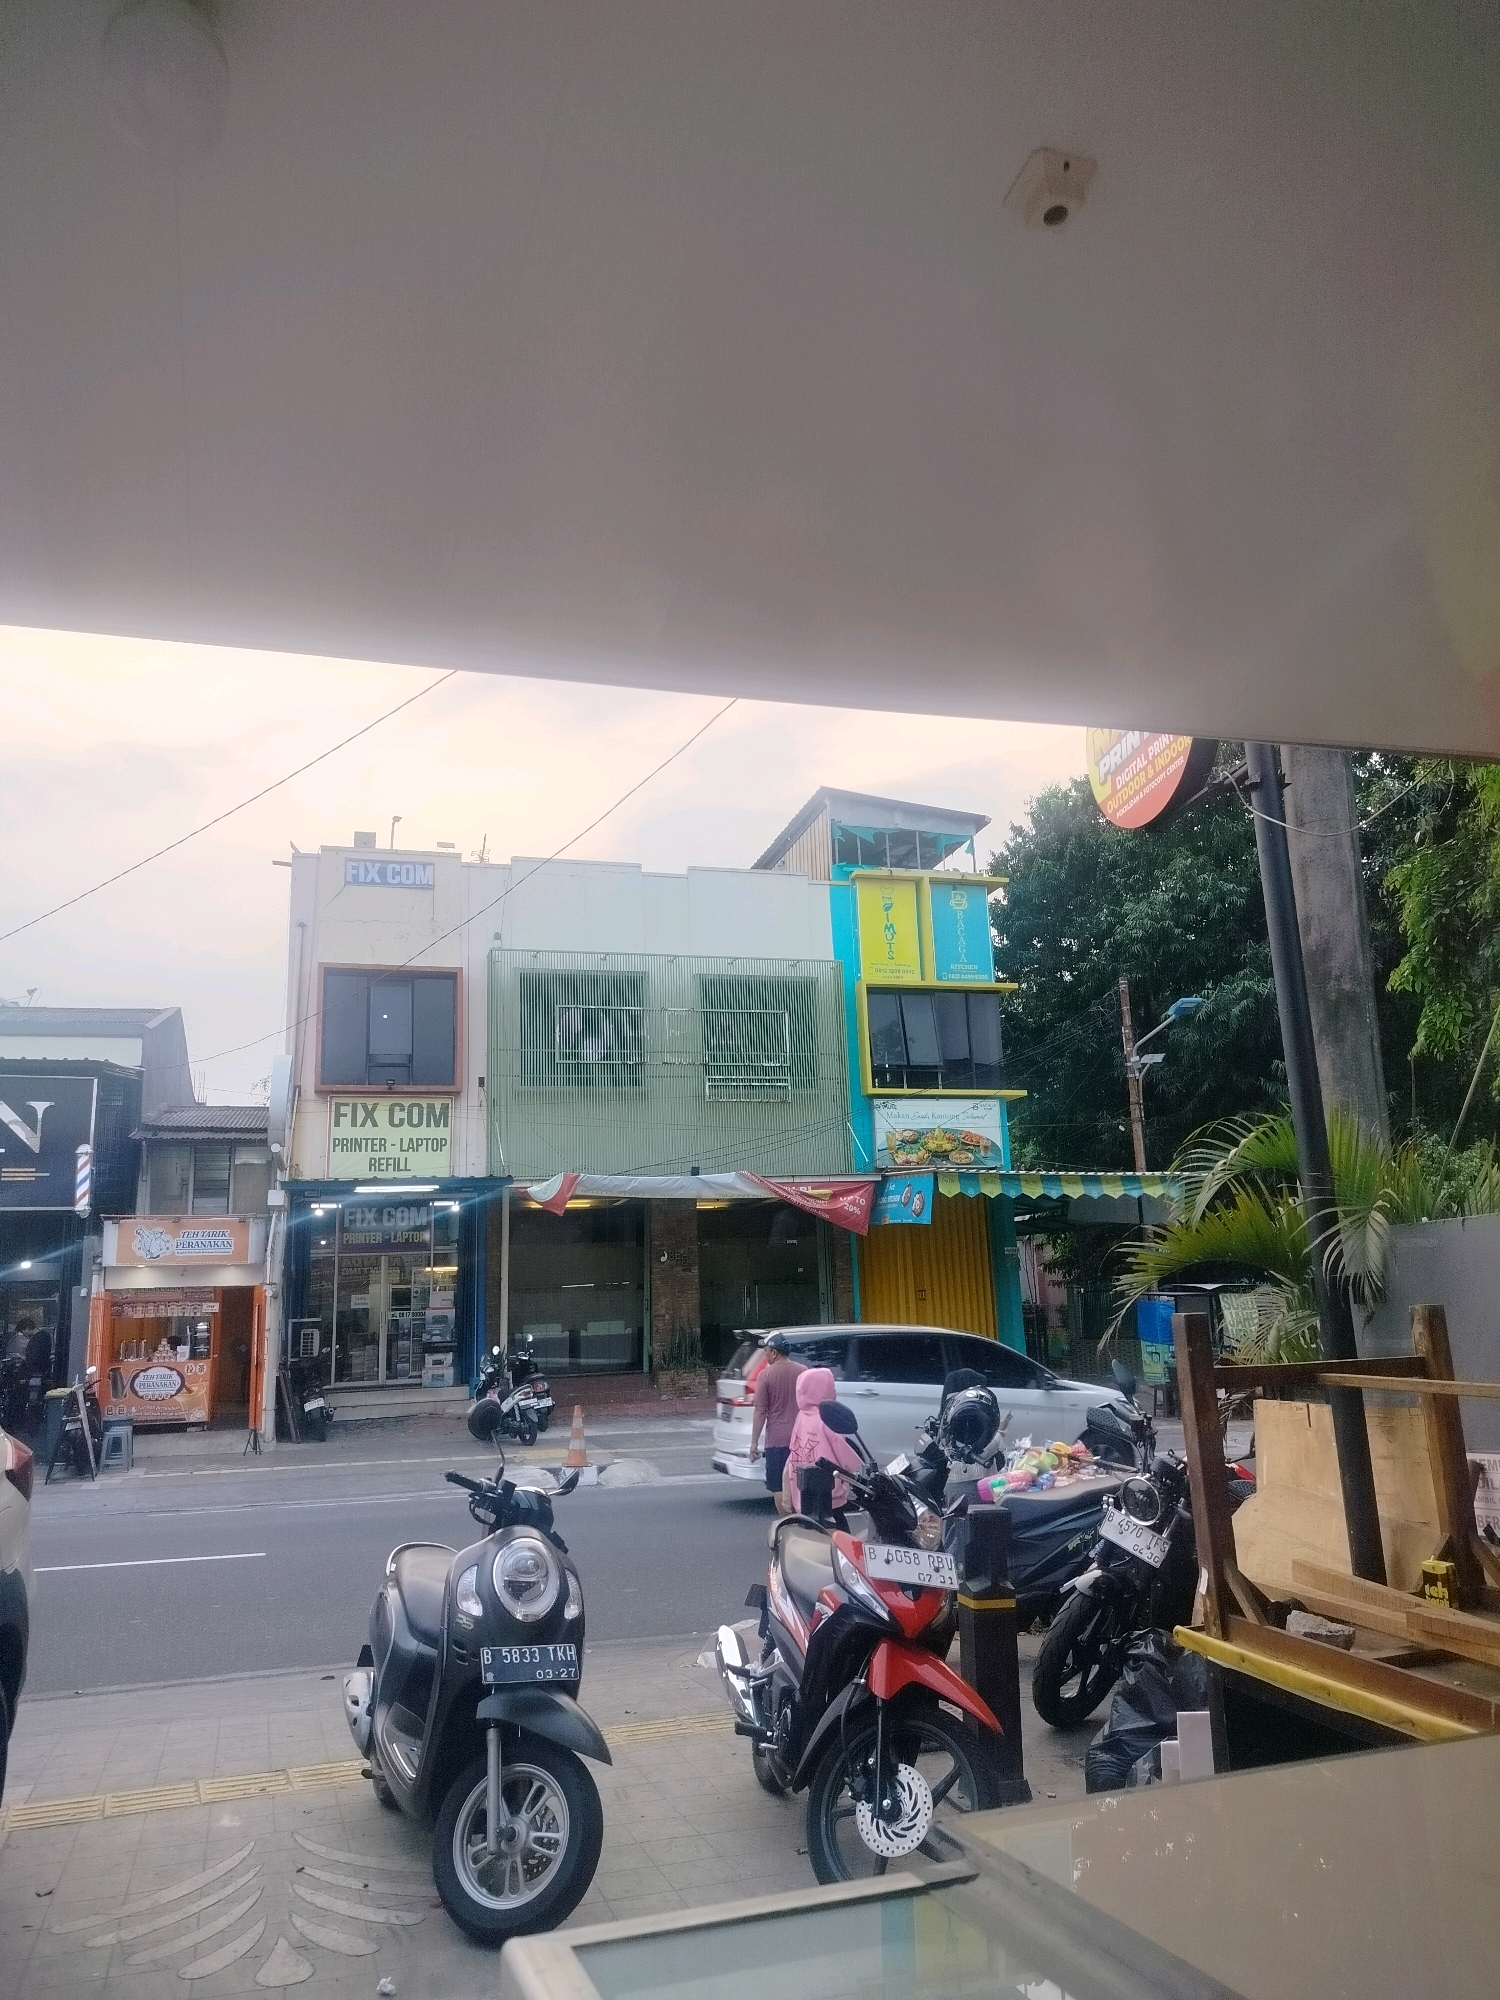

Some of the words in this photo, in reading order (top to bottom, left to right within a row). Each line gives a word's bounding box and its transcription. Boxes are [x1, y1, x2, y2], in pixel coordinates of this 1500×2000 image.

[1115, 753, 1148, 790] DIGITAL
[1143, 770, 1167, 796] FOTOCOPY
[1166, 755, 1185, 776] CENTER
[1106, 770, 1147, 814] OUTDOOR
[1147, 764, 1154, 779] &
[346, 861, 382, 883] FIX
[386, 863, 434, 885] COM
[333, 1102, 379, 1128] FIX
[388, 1102, 449, 1128] COM
[886, 1111, 910, 1119] Makan
[931, 1111, 960, 1121] Kantong
[332, 1137, 387, 1152] PRINTER
[399, 1138, 448, 1153] LAPTOP
[368, 1157, 411, 1172] REFILL
[855, 1195, 866, 1206] TO
[844, 1202, 861, 1215] 20%
[344, 1207, 377, 1227] FIX
[382, 1206, 428, 1226] COM
[181, 1231, 199, 1239] TEH
[199, 1230, 229, 1238] TARIK
[343, 1231, 382, 1244] PRINTER
[175, 1240, 233, 1249] PERANAKAN
[138, 1381, 177, 1389] PERANAKAN
[1107, 1511, 1115, 1523] B
[868, 1547, 877, 1560] B
[1424, 1581, 1449, 1600] teh
[483, 1649, 492, 1665] B
[502, 1648, 540, 1664] 5833
[547, 1646, 576, 1661] TKH
